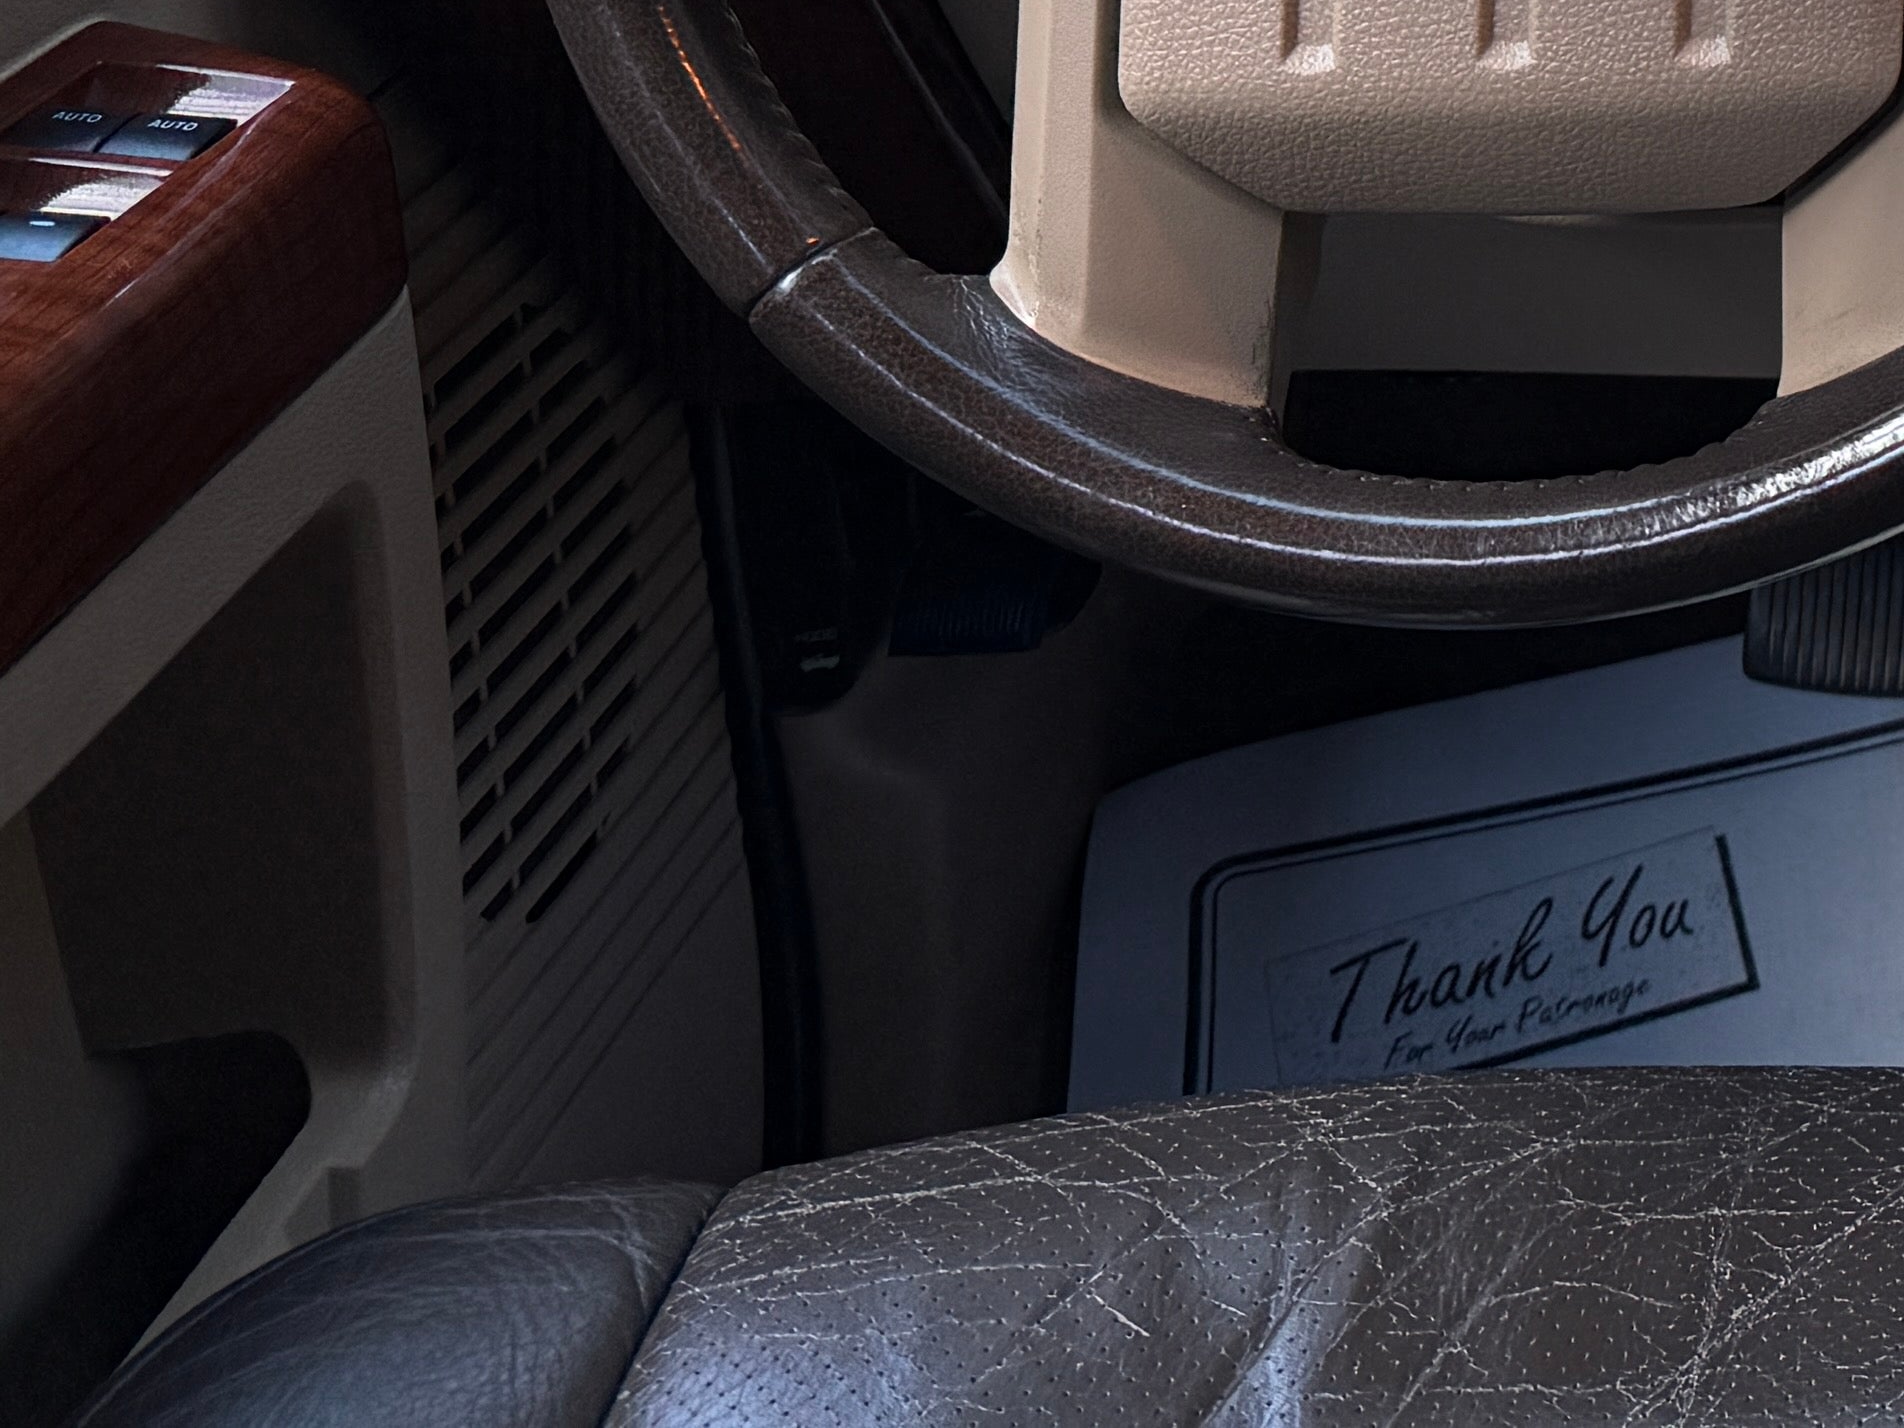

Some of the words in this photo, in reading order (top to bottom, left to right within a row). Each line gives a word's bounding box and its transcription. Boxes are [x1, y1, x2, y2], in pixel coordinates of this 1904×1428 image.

[51, 108, 102, 128] AUTO
[146, 116, 199, 135] AUTO
[1329, 895, 1555, 1044] Thank
[1579, 862, 1695, 969] You
[1384, 1030, 1434, 1071] For
[1446, 1014, 1506, 1055] Your
[1517, 978, 1651, 1034] Patronage
